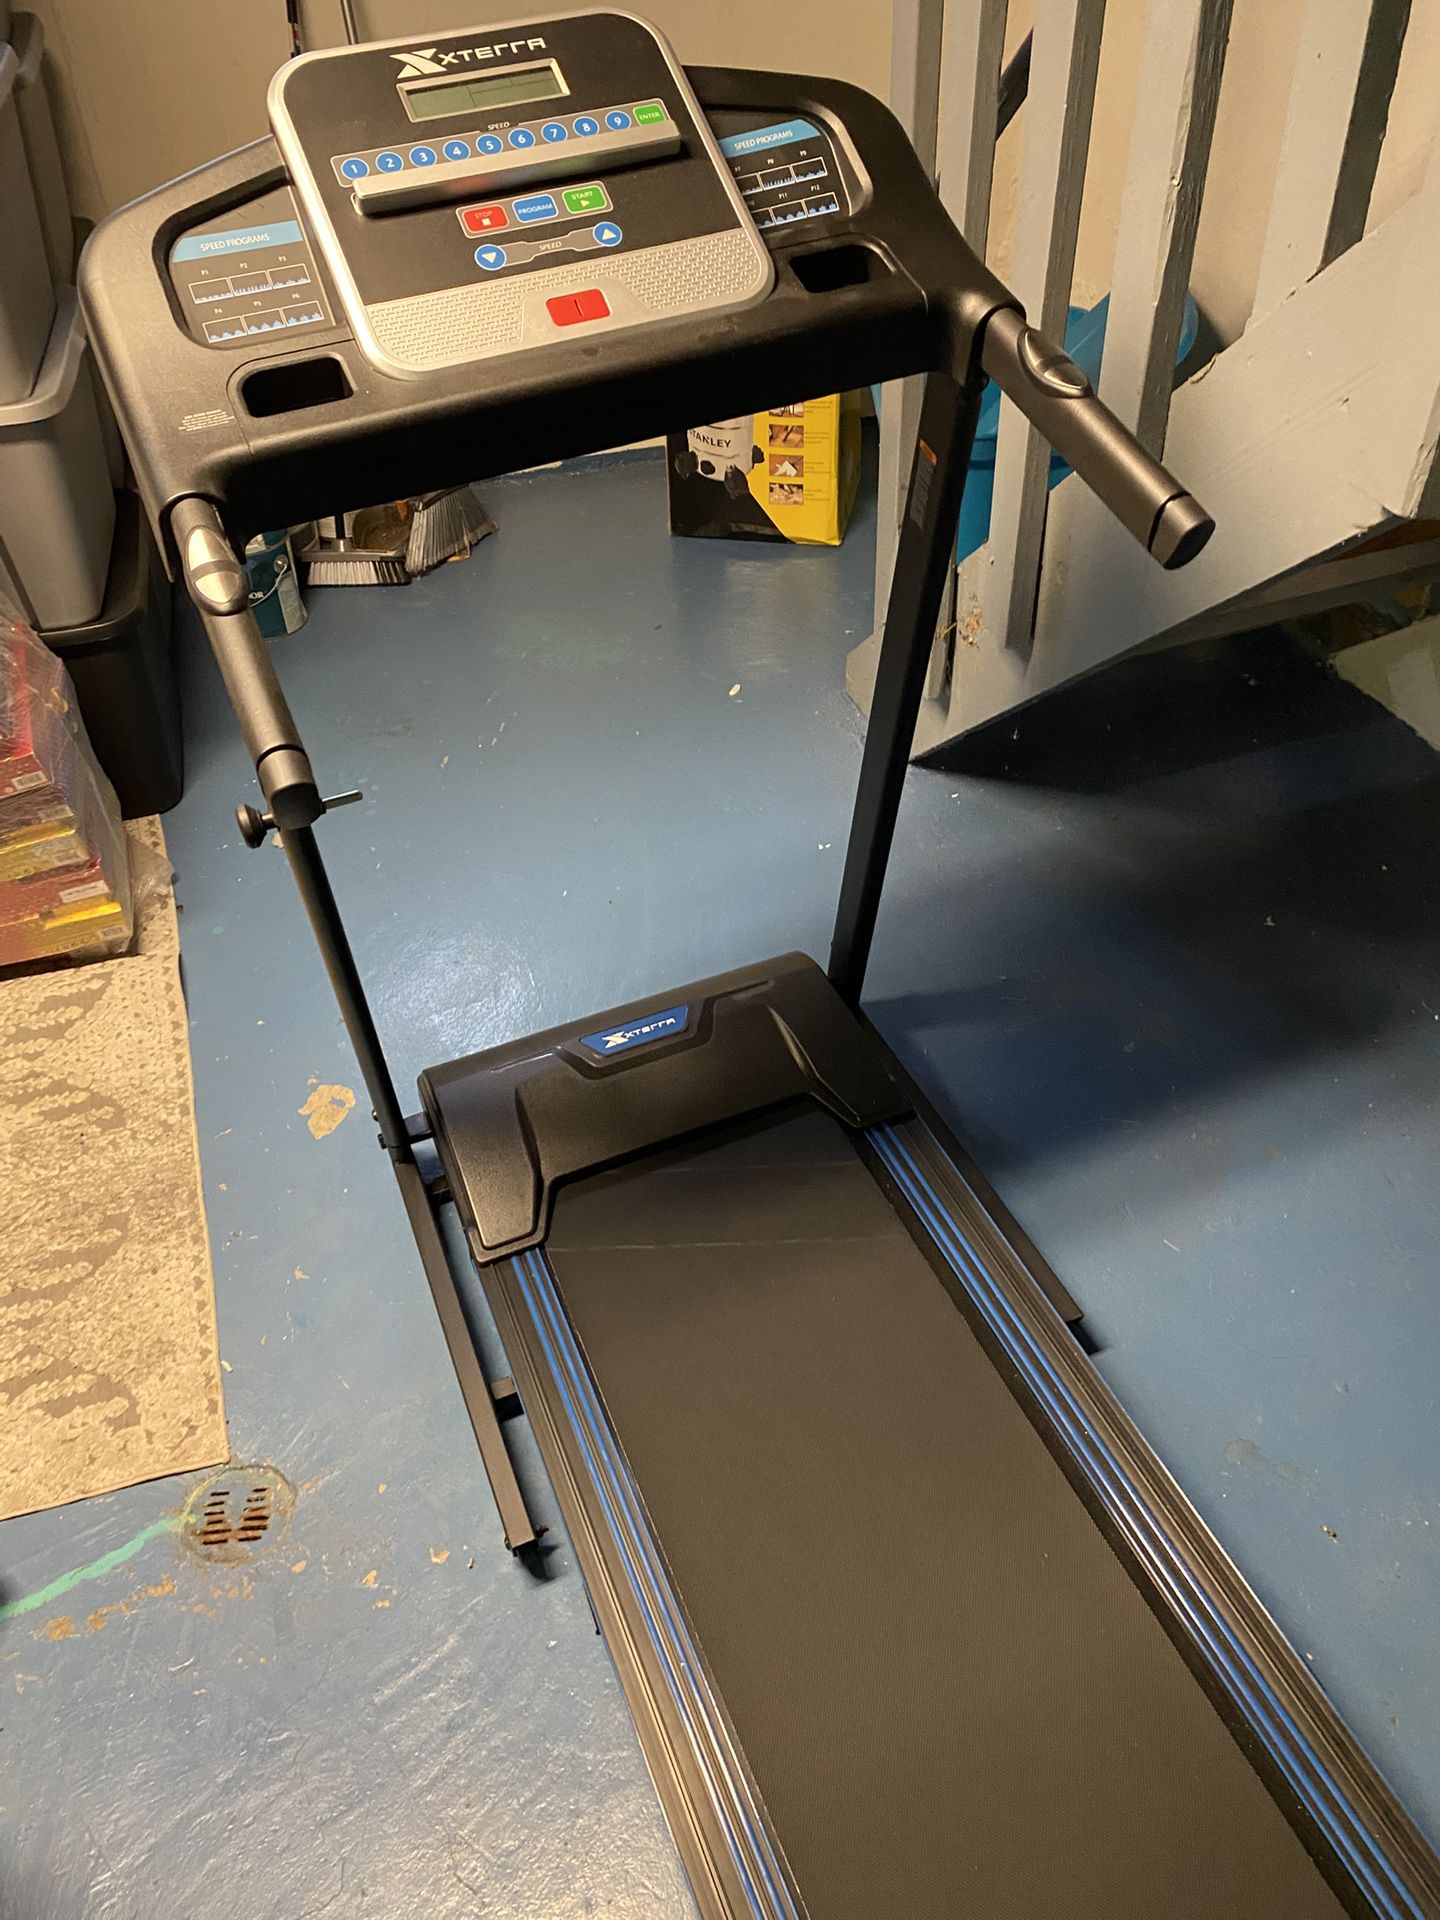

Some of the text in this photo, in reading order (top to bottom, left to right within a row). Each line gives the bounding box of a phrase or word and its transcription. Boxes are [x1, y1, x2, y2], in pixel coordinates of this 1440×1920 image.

[487, 121, 510, 131] SPEED
[351, 111, 660, 174] 1 2 3 4 5 6 7 8 9 ENTER
[734, 130, 793, 151] SPEED PROGRAMS
[474, 190, 593, 219] STOP PROGRAM START
[200, 233, 270, 252] SPEED PROGRAMS
[539, 240, 562, 251] SPEED
